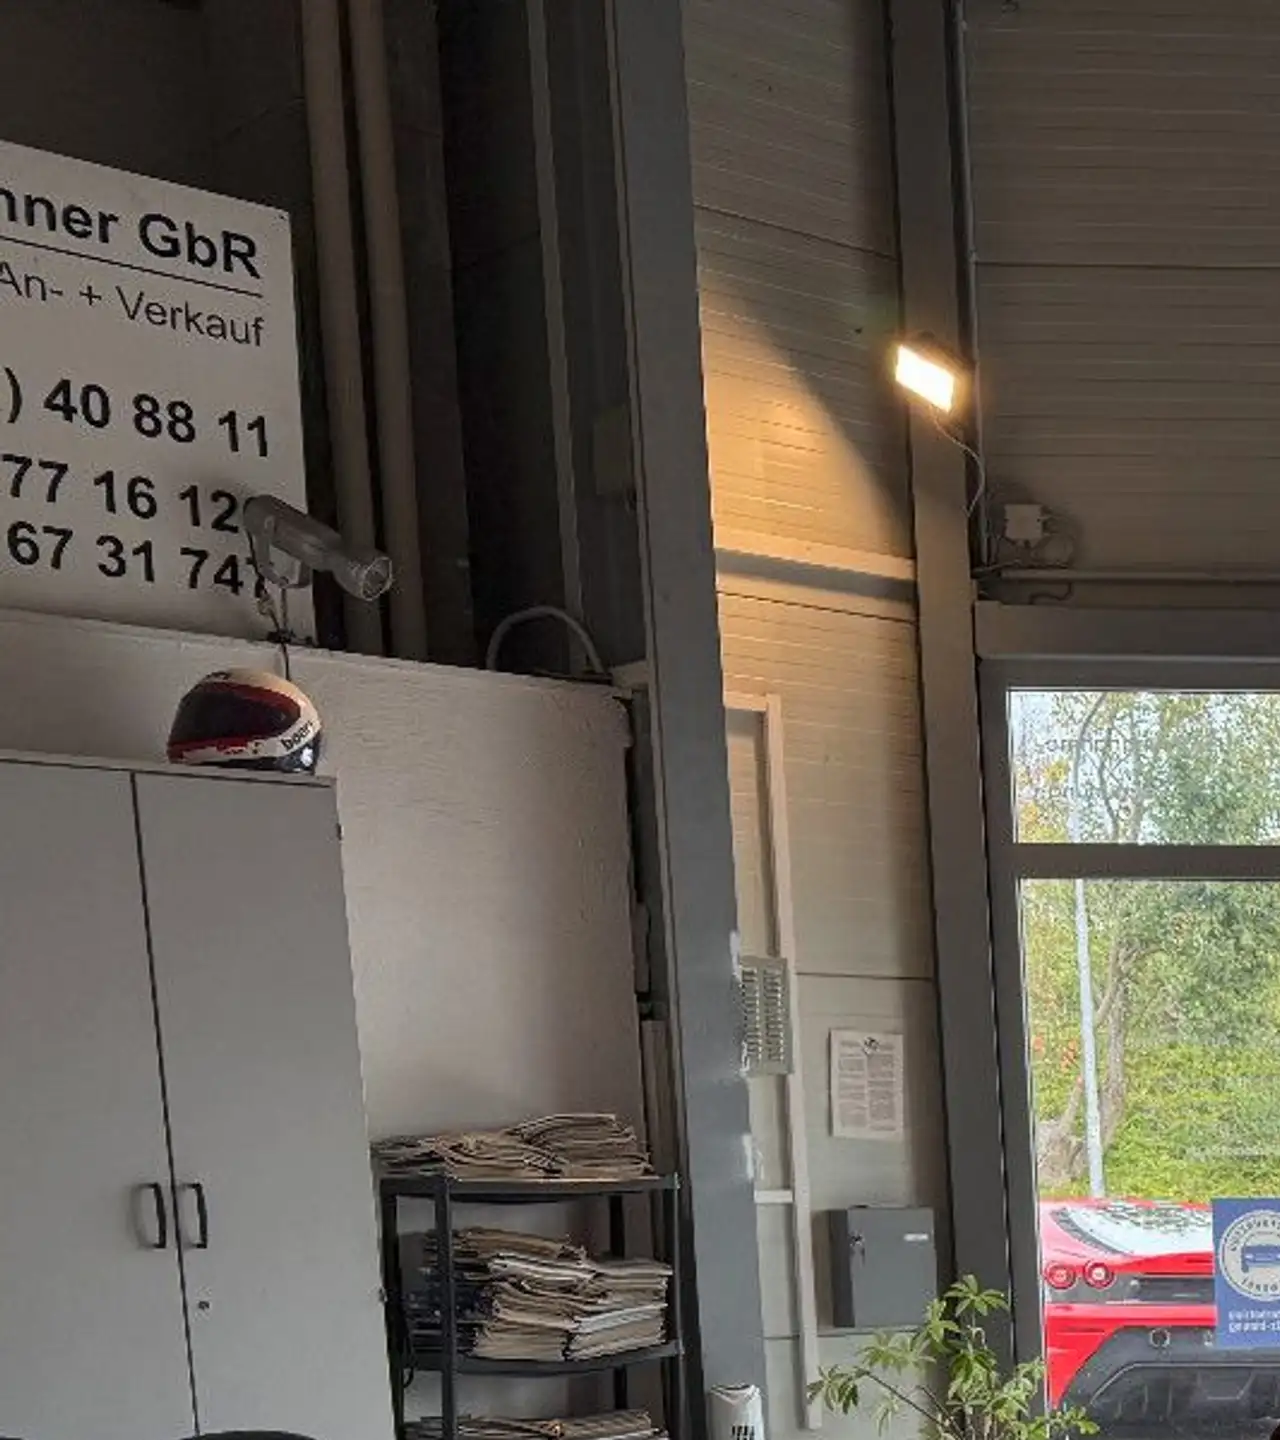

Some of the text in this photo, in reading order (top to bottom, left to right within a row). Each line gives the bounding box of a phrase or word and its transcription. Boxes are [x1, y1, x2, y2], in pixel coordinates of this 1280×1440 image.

[138, 213, 261, 279] GbR
[79, 285, 102, 307] +
[115, 286, 265, 347] Verkauf
[43, 379, 111, 428] 40
[133, 393, 196, 444] 88
[218, 410, 268, 457] 11
[93, 470, 158, 520] 16
[7, 521, 74, 571] 67
[96, 535, 155, 583] 31
